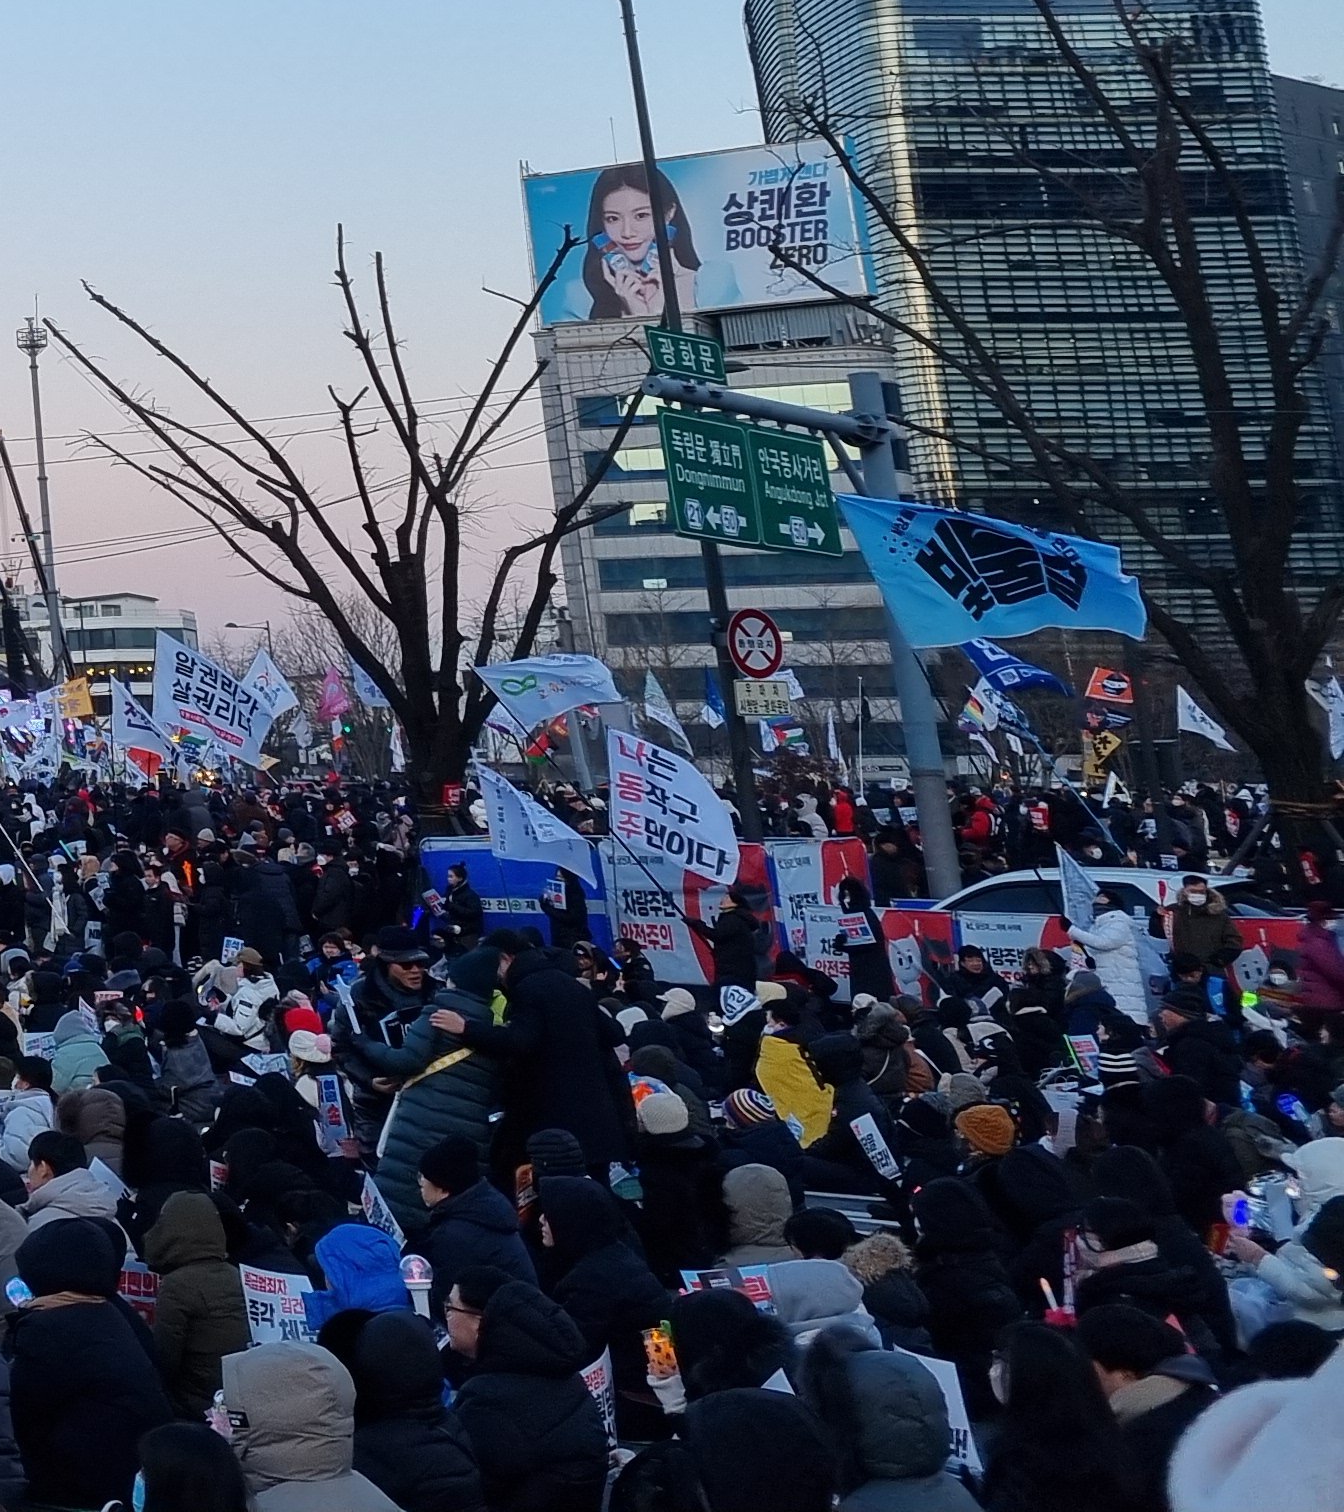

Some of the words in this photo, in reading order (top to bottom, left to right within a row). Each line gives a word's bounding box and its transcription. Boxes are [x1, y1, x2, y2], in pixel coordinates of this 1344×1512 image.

[722, 181, 831, 227] 상쾌환
[725, 219, 829, 251] BOOSTER
[769, 244, 828, 270] ZERO
[658, 337, 715, 374] 광화문
[671, 428, 707, 463] 독립문
[675, 463, 746, 493] Dongnimmun
[758, 447, 824, 485] 안국동사거리
[175, 651, 259, 715] 알권리가
[617, 736, 679, 781] 나는
[616, 772, 700, 824] 동작구
[617, 810, 731, 876] 주민이다
[249, 1298, 276, 1329] 즉각
[280, 1296, 304, 1315] 김건
